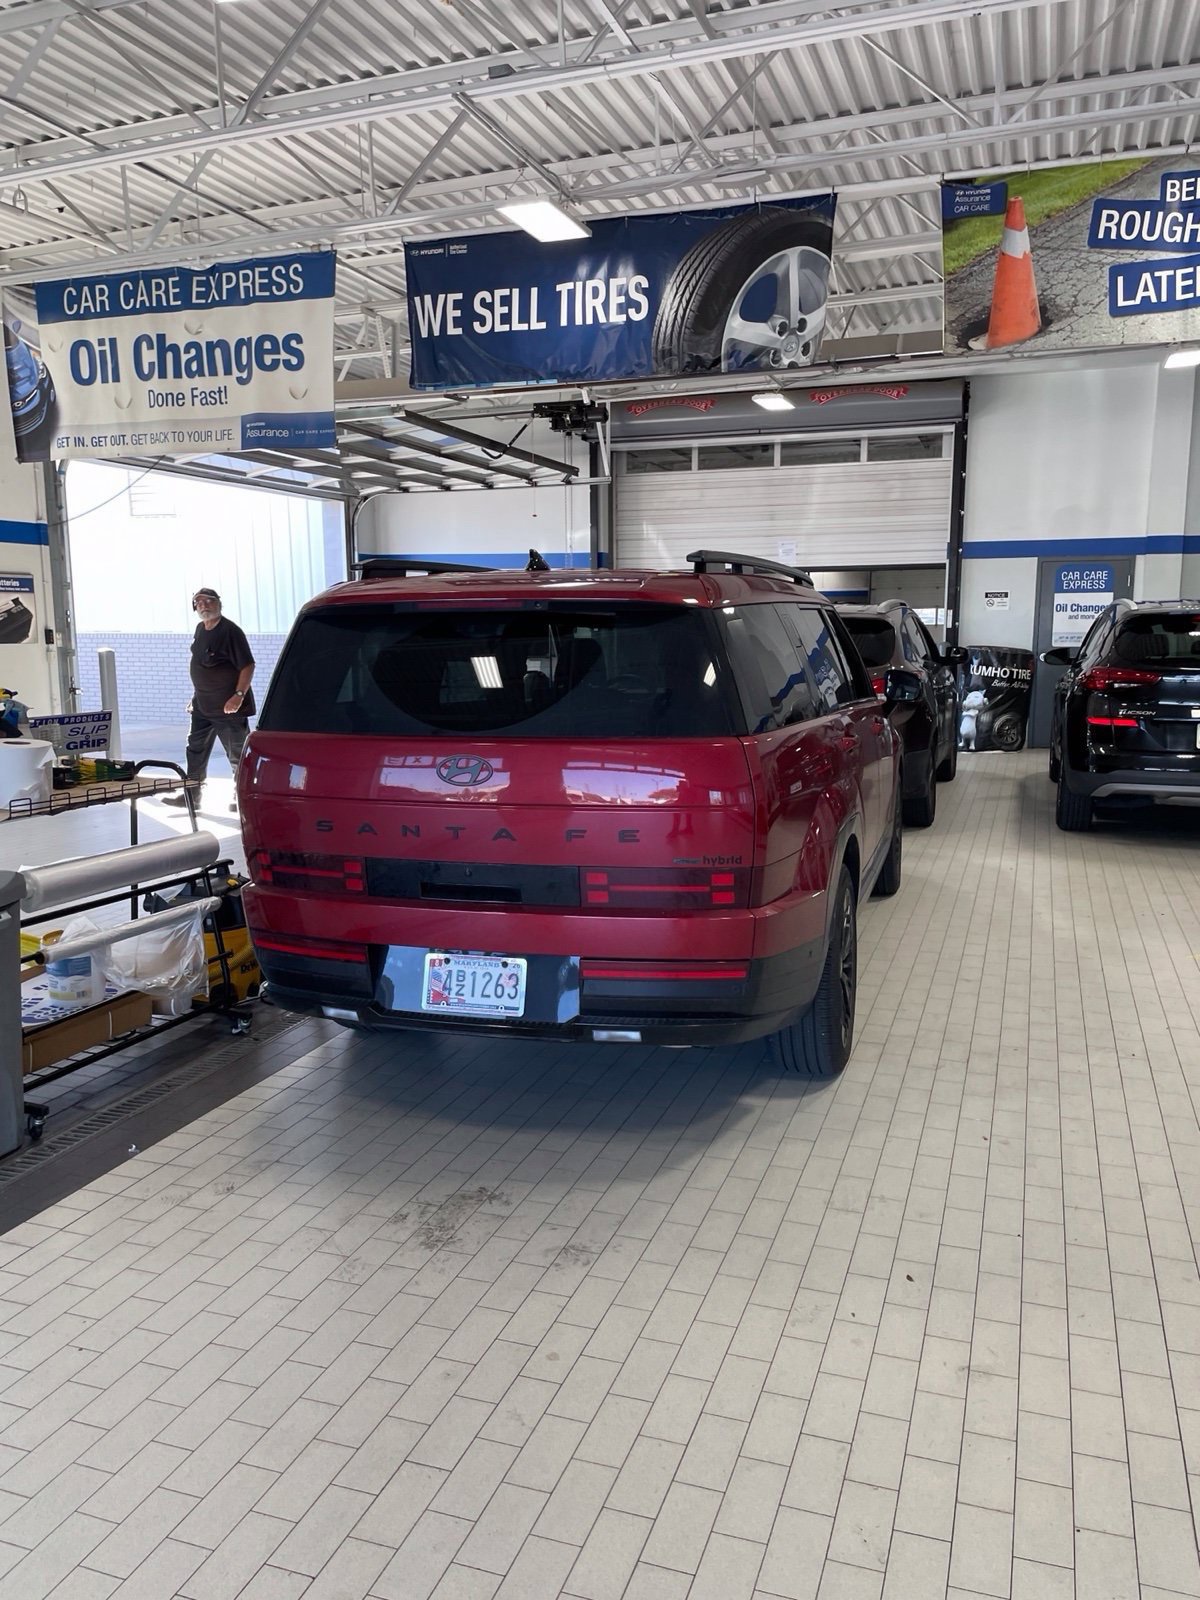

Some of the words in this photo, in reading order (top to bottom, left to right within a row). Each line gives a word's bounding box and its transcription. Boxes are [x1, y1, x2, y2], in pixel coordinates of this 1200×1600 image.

[1165, 177, 1200, 202] BE
[954, 205, 969, 213] CAR
[63, 285, 110, 315] CAR
[119, 276, 181, 310] CARE
[192, 263, 304, 304] EXPRESS
[1117, 265, 1200, 307] LATE
[414, 292, 463, 338] WE
[472, 286, 547, 334] SELL
[556, 274, 649, 327] TIRES
[69, 337, 120, 387] Oil
[133, 333, 305, 386] Changes
[148, 389, 185, 409] Done
[191, 385, 228, 407] Fast!
[873, 386, 898, 397] DOOR
[684, 398, 707, 410] DOOR
[56, 436, 70, 448] GET
[73, 436, 89, 448] IN.
[91, 435, 108, 448] GET
[110, 434, 129, 446] OUT.
[130, 433, 149, 446] GET
[150, 431, 170, 445] BACK
[171, 431, 185, 443] TO
[186, 429, 213, 443] YOUR
[215, 428, 235, 442] LIFE.
[246, 428, 289, 438] Assurance
[1061, 571, 1080, 580] CAR
[1083, 570, 1108, 580] CARE
[1063, 580, 1106, 590] EXPRESS
[1055, 603, 1068, 613] Oil
[1011, 668, 1032, 680] TIRE
[64, 713, 110, 724] PRODUCTS
[67, 724, 109, 737] SLIP
[65, 738, 108, 751] GRIP
[316, 819, 517, 842] SANTA
[564, 829, 641, 843] FE
[702, 855, 743, 866] hybrid
[453, 960, 501, 969] MARYLAND
